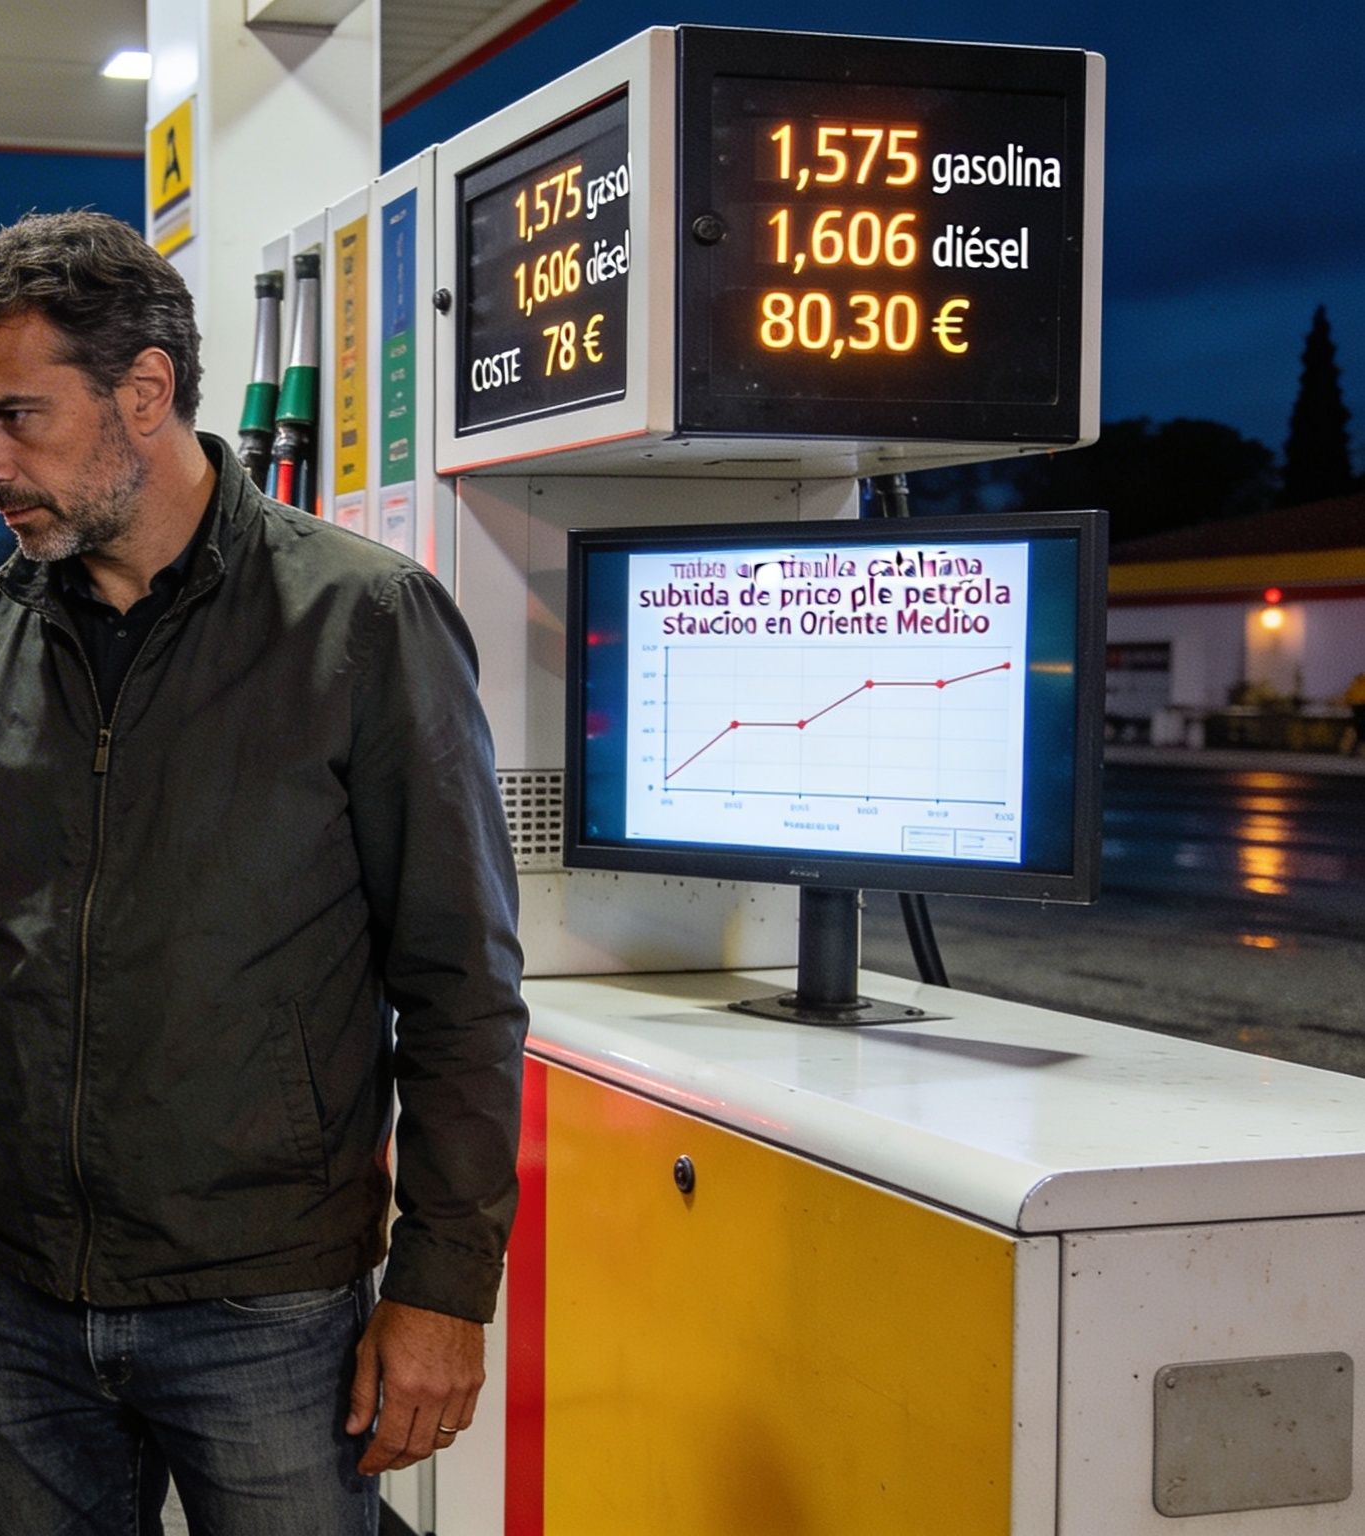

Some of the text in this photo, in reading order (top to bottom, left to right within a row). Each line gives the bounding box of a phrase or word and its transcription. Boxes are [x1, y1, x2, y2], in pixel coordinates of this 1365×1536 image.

[770, 124, 1061, 194] 1,575 gasolina
[515, 165, 582, 242] 1,575
[768, 209, 1029, 274] 1,606 diésel
[514, 243, 580, 317] 1,606
[471, 314, 604, 392] COSTE 78 €
[759, 292, 970, 359] 80,30 €
[739, 583, 771, 606] de
[765, 617, 792, 635] en
[800, 610, 887, 635] Oriente
